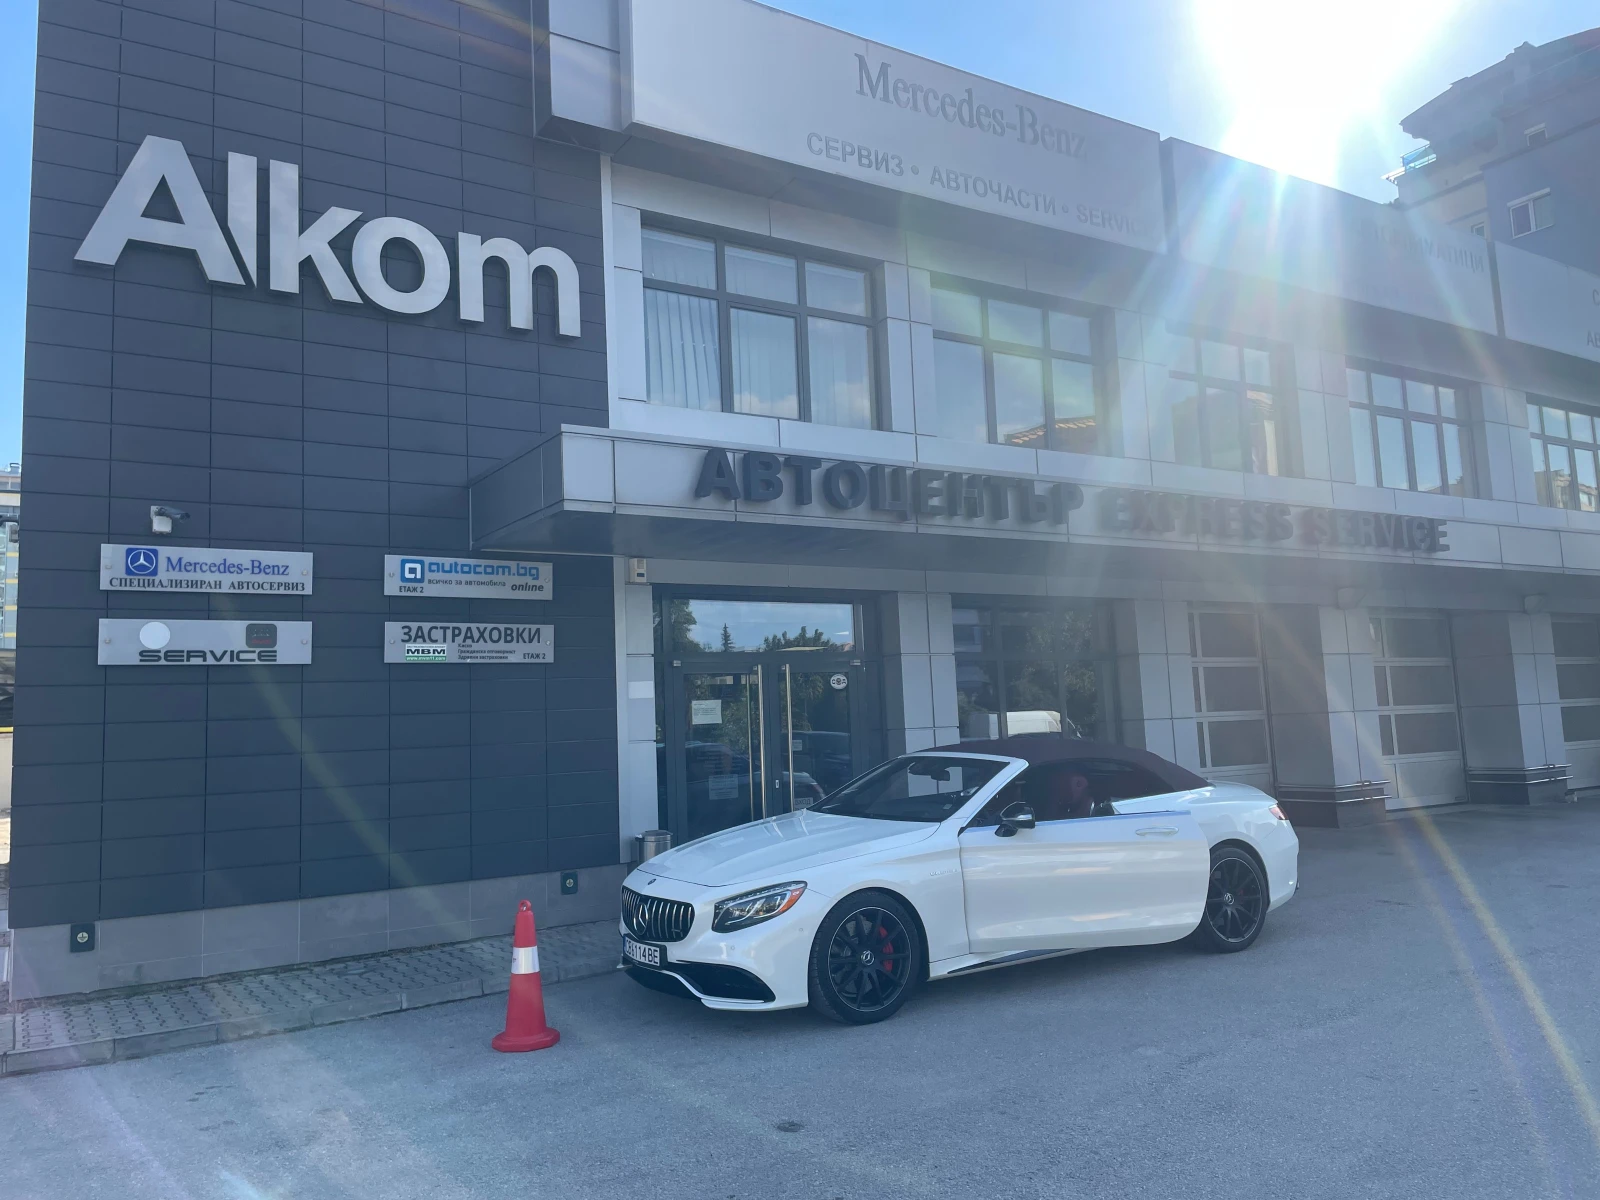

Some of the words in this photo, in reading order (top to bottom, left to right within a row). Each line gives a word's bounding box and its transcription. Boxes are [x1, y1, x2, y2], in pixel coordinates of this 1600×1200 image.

[854, 53, 1088, 160] Mercedes-Benz
[806, 131, 905, 177] СЕРВИЗ
[929, 165, 1057, 216] АВТОЧАСТИ
[1075, 202, 1148, 238] SERVIC
[73, 134, 582, 338] Alkom
[694, 447, 1084, 525] АВТОЦЕНТЪР
[1097, 486, 1294, 541] EXPRESS
[1301, 506, 1450, 554] SERVICE
[165, 556, 290, 576] Mercedes-Benz
[427, 561, 540, 580] autocom.bg
[109, 577, 222, 590] СПЕЦИАЛИЗИРАН
[228, 581, 305, 591] АВТОСЕРВИЗ
[464, 579, 506, 587] автомобила
[510, 582, 544, 592] online
[400, 625, 541, 644] ЗАСТРАХОВКИ
[138, 649, 278, 662] SERVICE
[523, 652, 540, 660] ЕТАЖ
